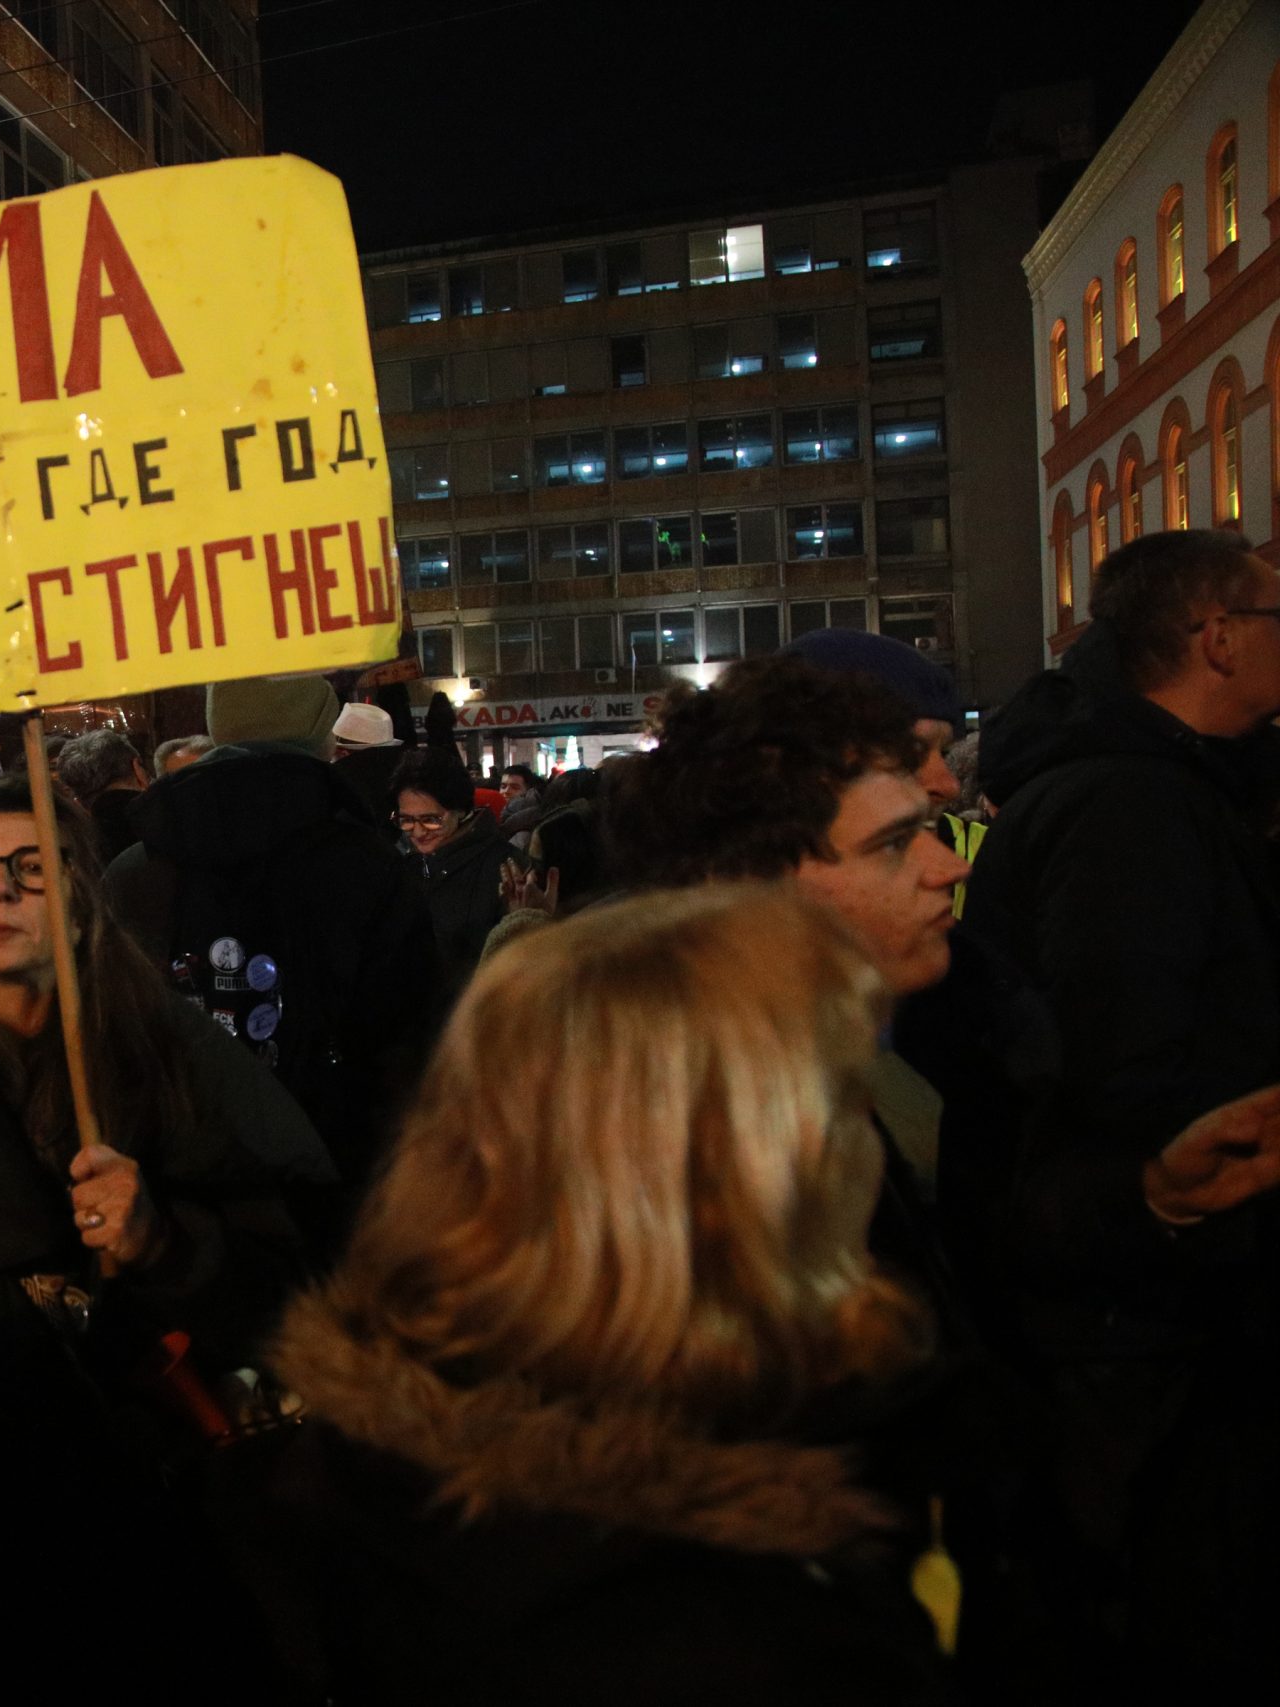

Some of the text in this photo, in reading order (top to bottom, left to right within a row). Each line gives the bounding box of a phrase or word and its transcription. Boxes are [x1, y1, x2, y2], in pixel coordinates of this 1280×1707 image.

[36, 409, 377, 521] ГДЕ ГОД
[27, 516, 396, 674] СТИГНЕШ
